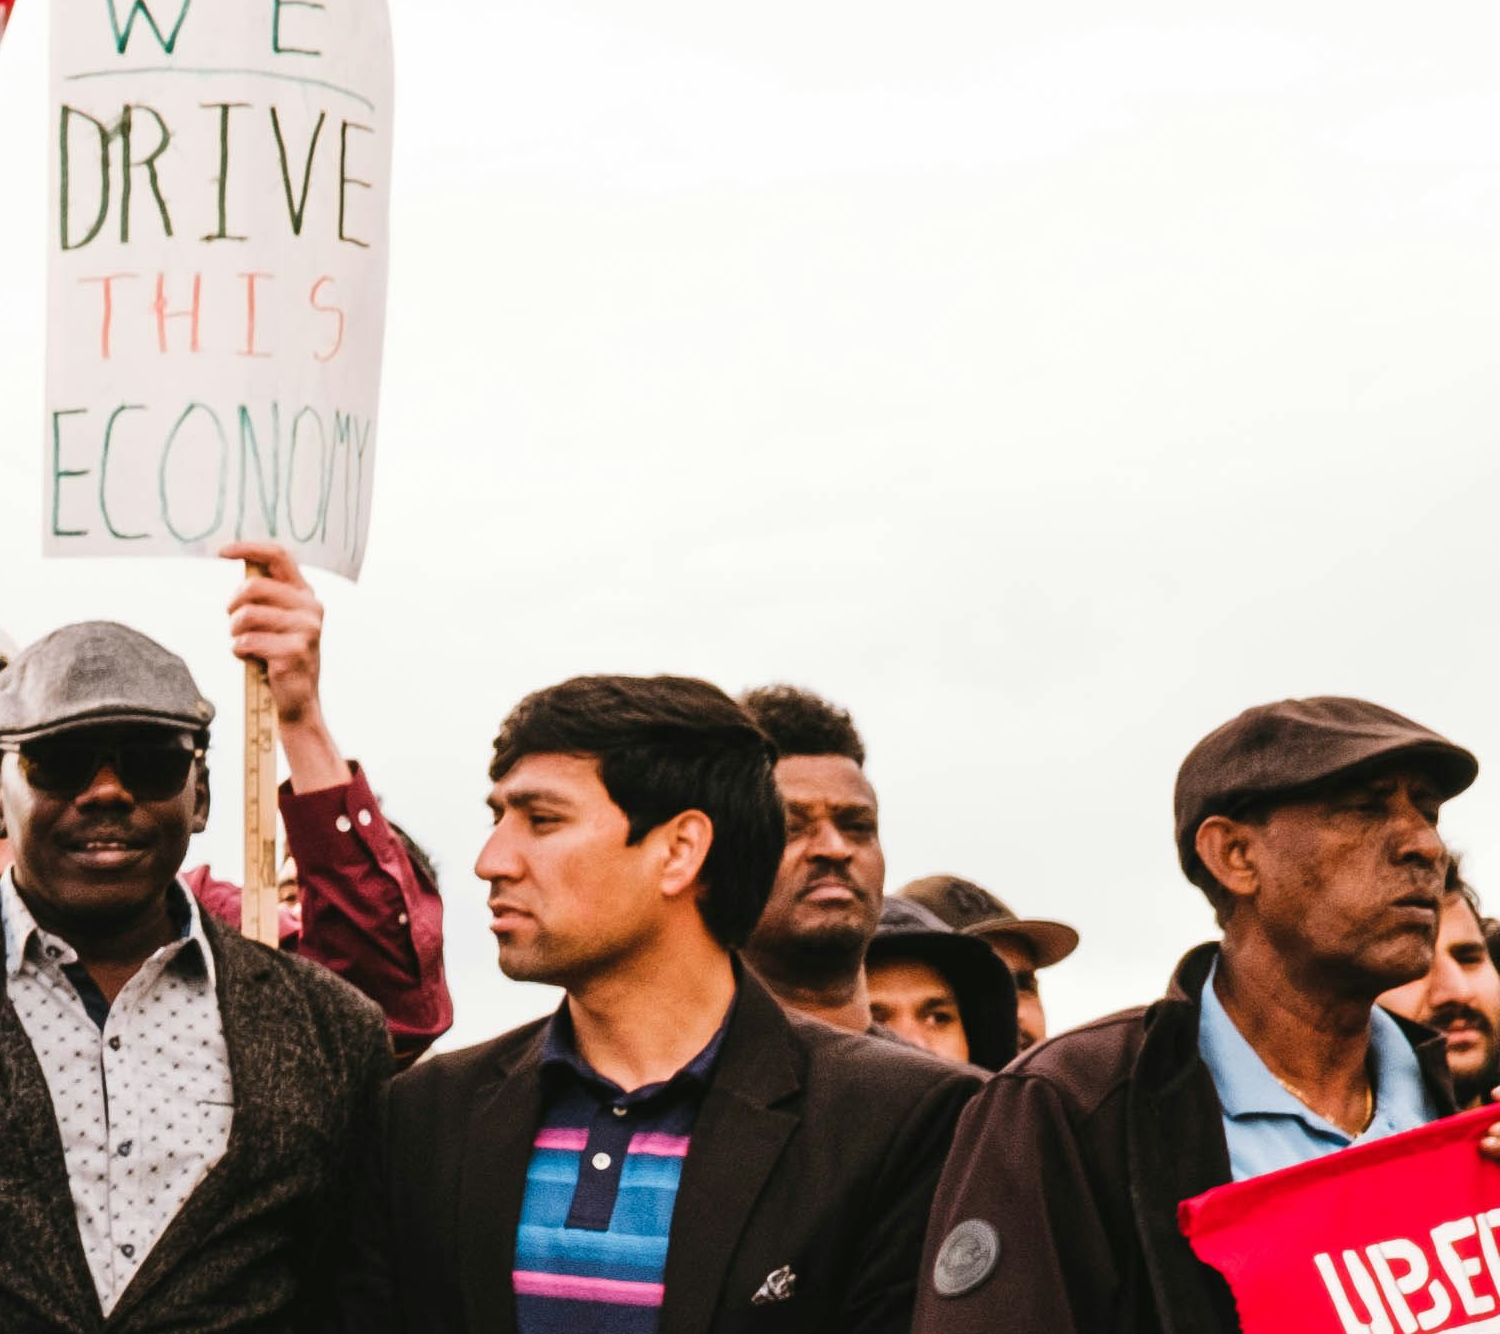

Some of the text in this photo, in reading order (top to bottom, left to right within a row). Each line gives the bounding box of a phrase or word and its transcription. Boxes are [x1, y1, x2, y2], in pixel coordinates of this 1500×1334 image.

[60, 103, 375, 251] DRIVE
[78, 272, 345, 363] THIS
[52, 403, 371, 563] ECONOMY
